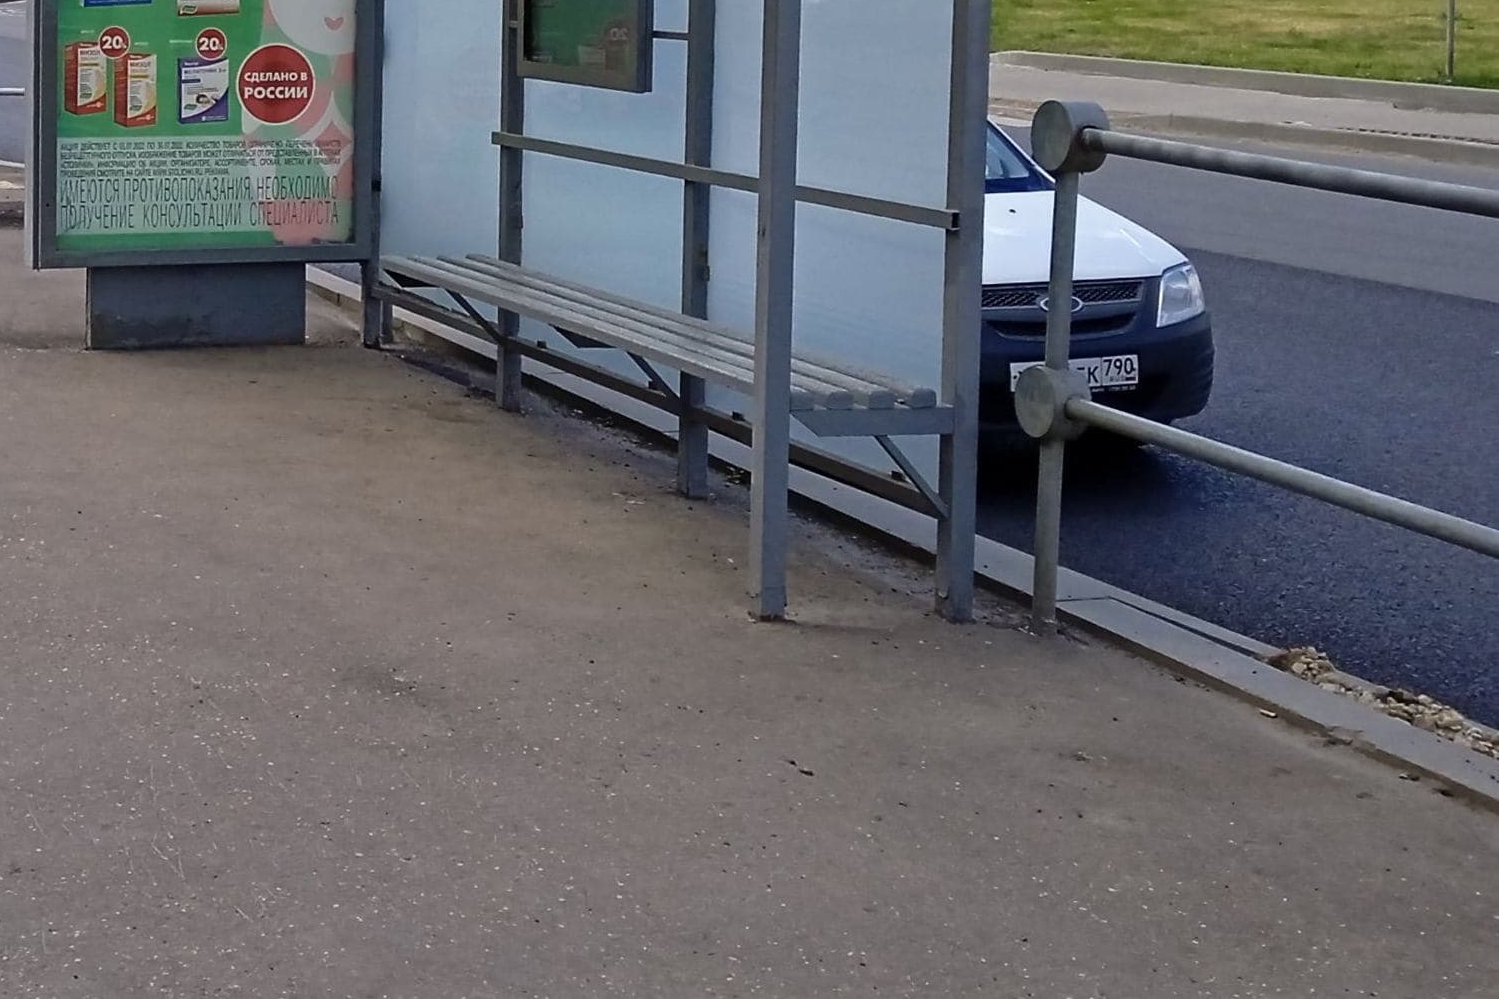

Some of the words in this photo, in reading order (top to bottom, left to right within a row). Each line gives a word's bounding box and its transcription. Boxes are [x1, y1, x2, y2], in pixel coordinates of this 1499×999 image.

[244, 72, 298, 83] СДЕЛАНО
[300, 72, 308, 81] В
[244, 87, 308, 99] РОССИИ
[61, 179, 120, 204] ИМЕЮТСЯ
[257, 175, 338, 201] НЕОБХОДИМО
[61, 204, 134, 229] ПОЛУЧЕНИЕ
[143, 202, 242, 229] КОНСУЛЬТАЦИИ
[249, 200, 339, 226] СПЕЦИАЛИСТА
[1103, 357, 1134, 376] 790
